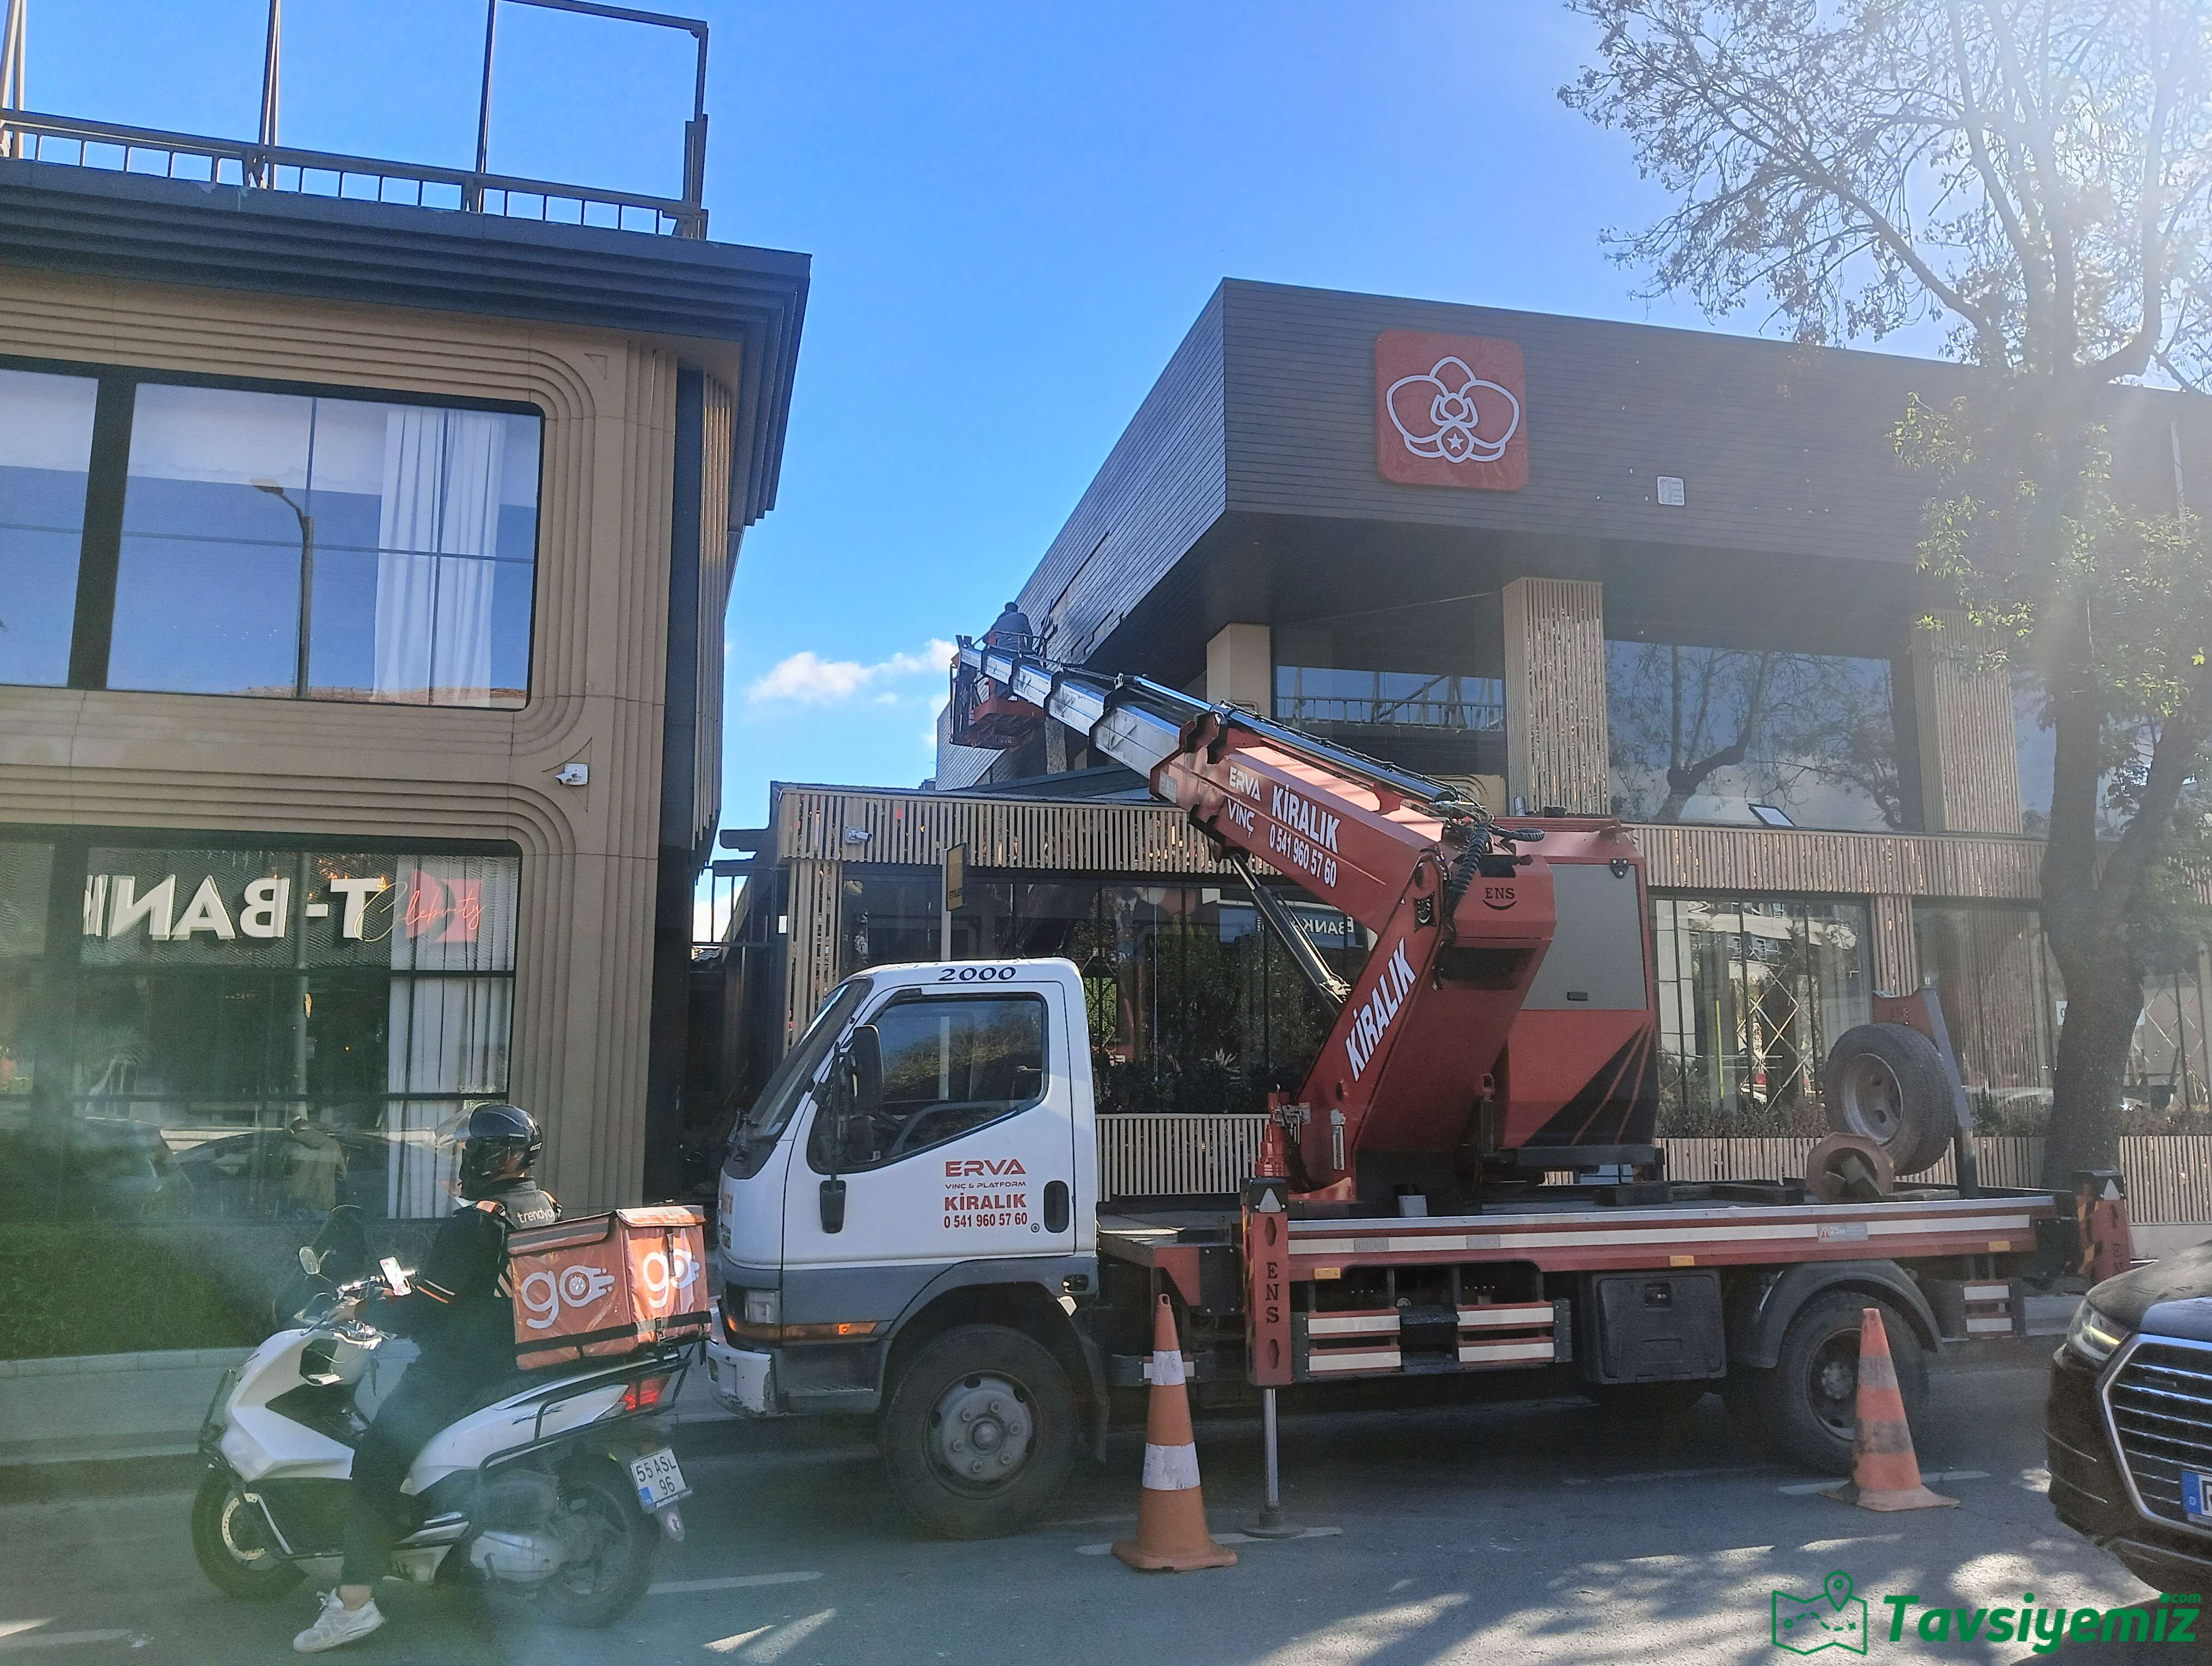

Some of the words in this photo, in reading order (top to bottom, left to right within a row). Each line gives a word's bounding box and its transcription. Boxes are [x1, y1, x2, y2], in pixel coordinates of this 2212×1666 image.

[1229, 766, 1262, 802] ERVA
[1271, 784, 1341, 854] KİRALIK
[1270, 824, 1276, 849] 0
[1276, 828, 1291, 858] 541
[1293, 838, 1309, 870] 960
[1310, 849, 1324, 879] 57
[1324, 856, 1337, 888] 60
[1486, 887, 1515, 900] ENS
[938, 967, 1016, 982] 2000
[1345, 937, 1416, 1082] KİRALIK
[946, 1159, 1026, 1177] ERVA
[944, 1193, 1027, 1211] KİRALIK
[944, 1216, 950, 1228] 0
[954, 1215, 972, 1228] 541
[976, 1214, 995, 1227] 960
[999, 1213, 1012, 1226] 57
[1015, 1212, 1028, 1225] 60
[643, 1249, 700, 1309] go
[1265, 1262, 1280, 1324] ENS
[521, 1265, 615, 1329] go
[636, 1463, 653, 1482] 55
[654, 1456, 677, 1475] ASL
[659, 1476, 676, 1496] 96
